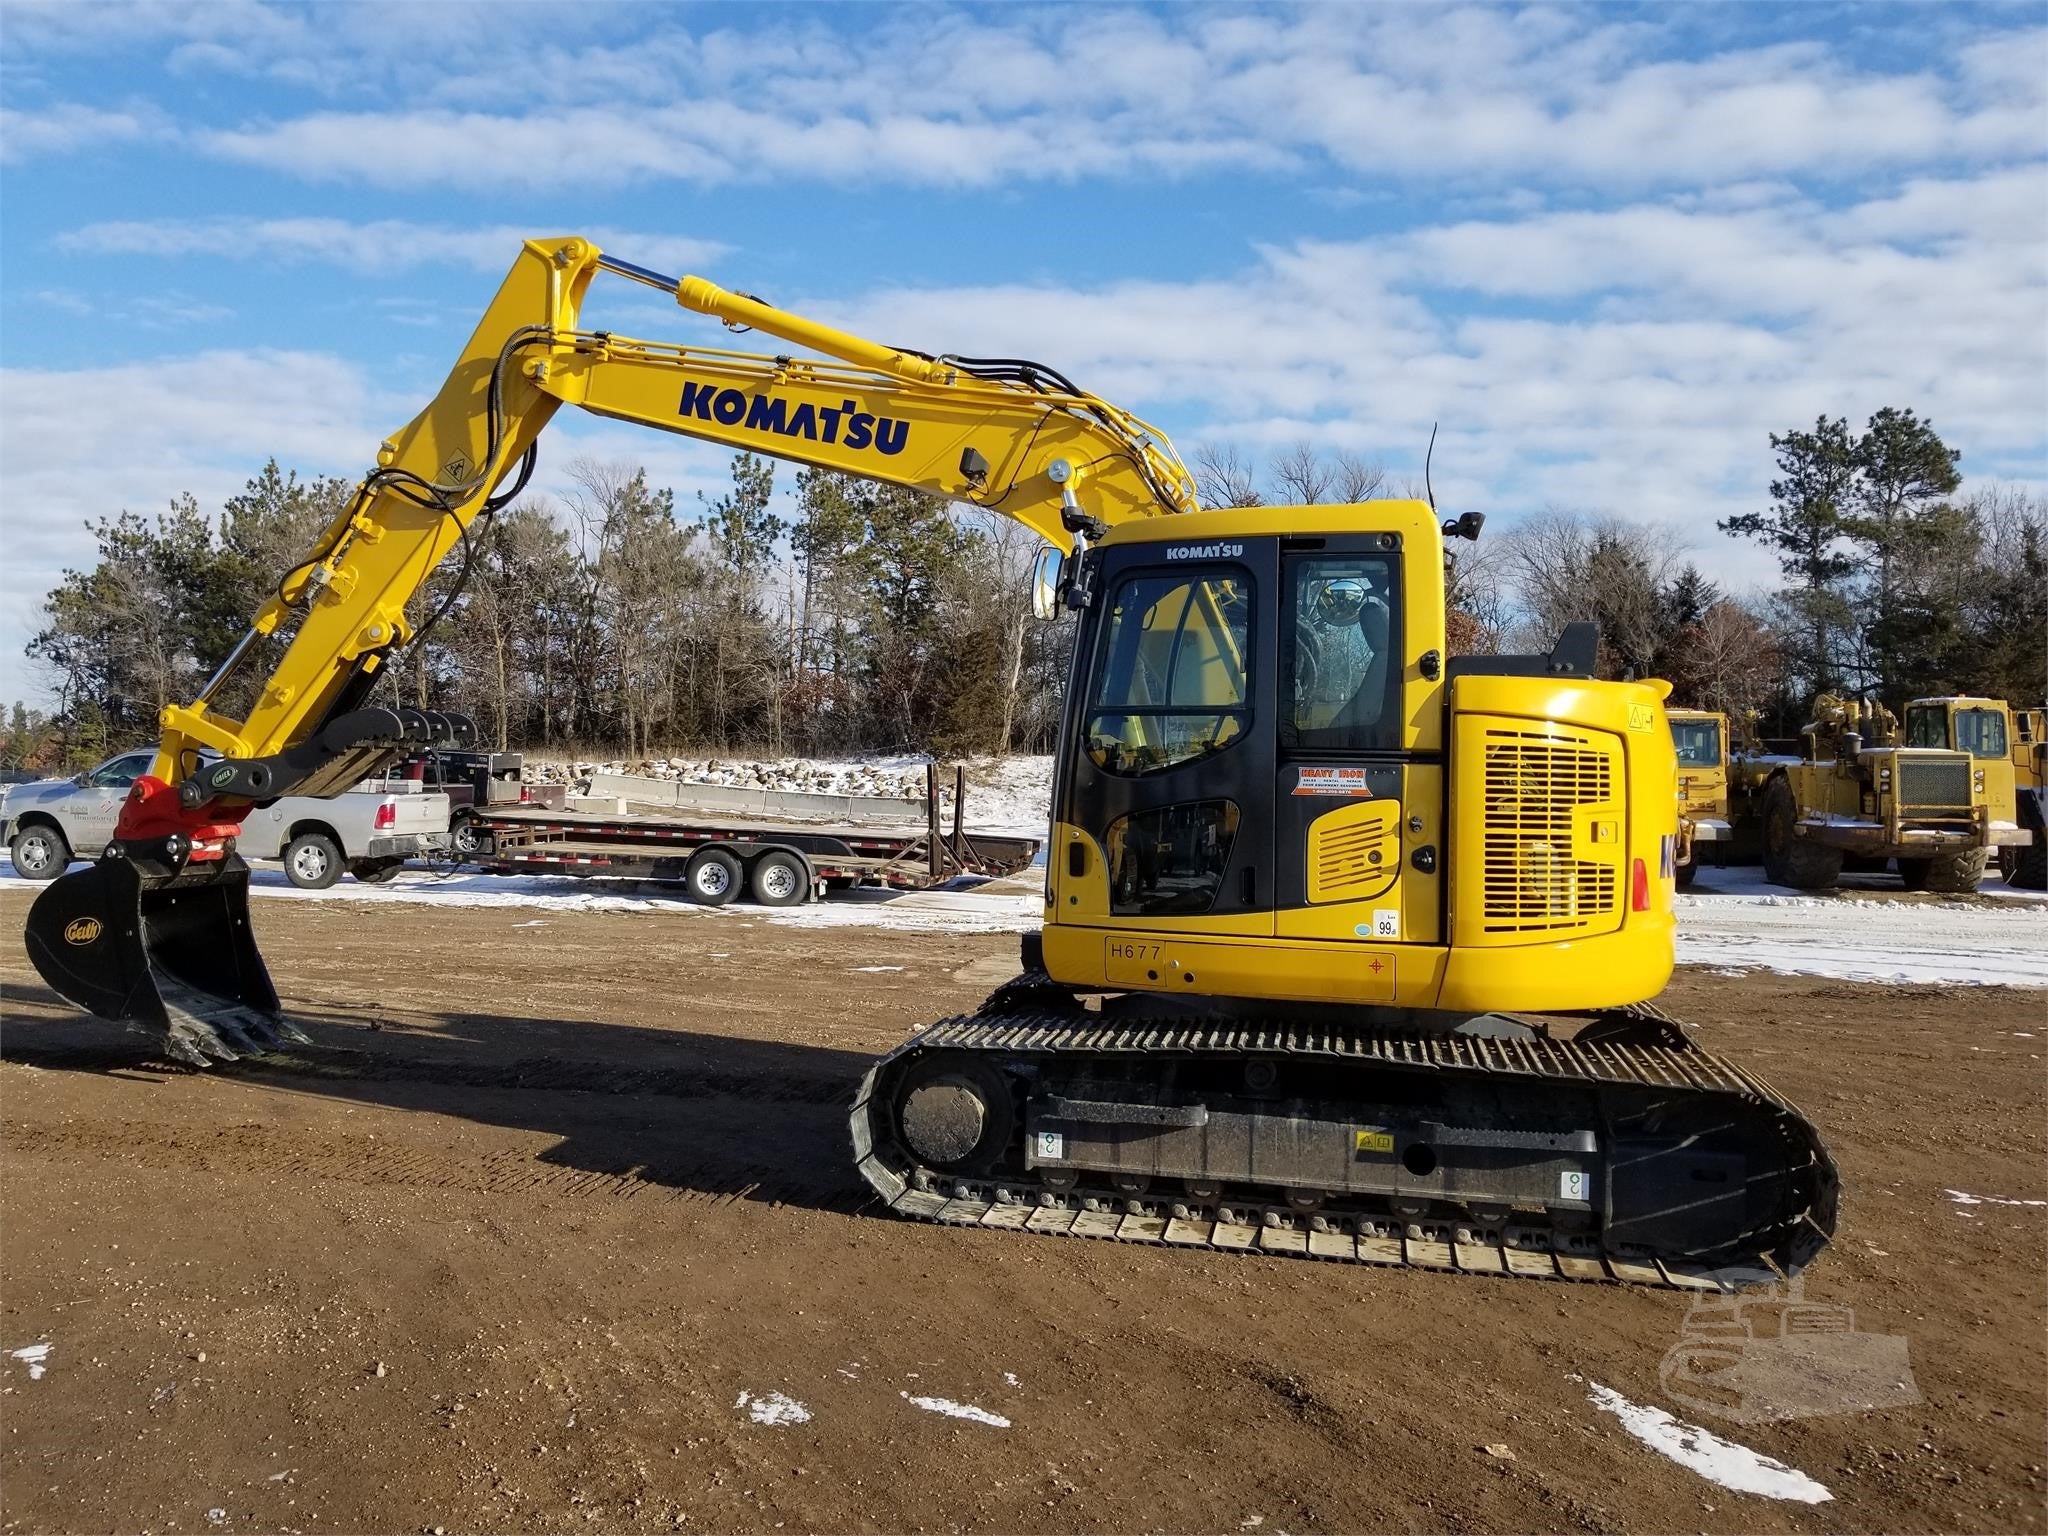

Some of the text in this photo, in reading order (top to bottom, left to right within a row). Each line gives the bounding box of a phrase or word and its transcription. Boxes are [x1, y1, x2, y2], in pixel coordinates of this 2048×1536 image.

[678, 381, 910, 455] KOMATSU
[1166, 542, 1244, 560] KOMATSU
[1301, 769, 1363, 778] HEAVY IRON
[1379, 921, 1392, 935] 99
[1111, 943, 1160, 960] H677
